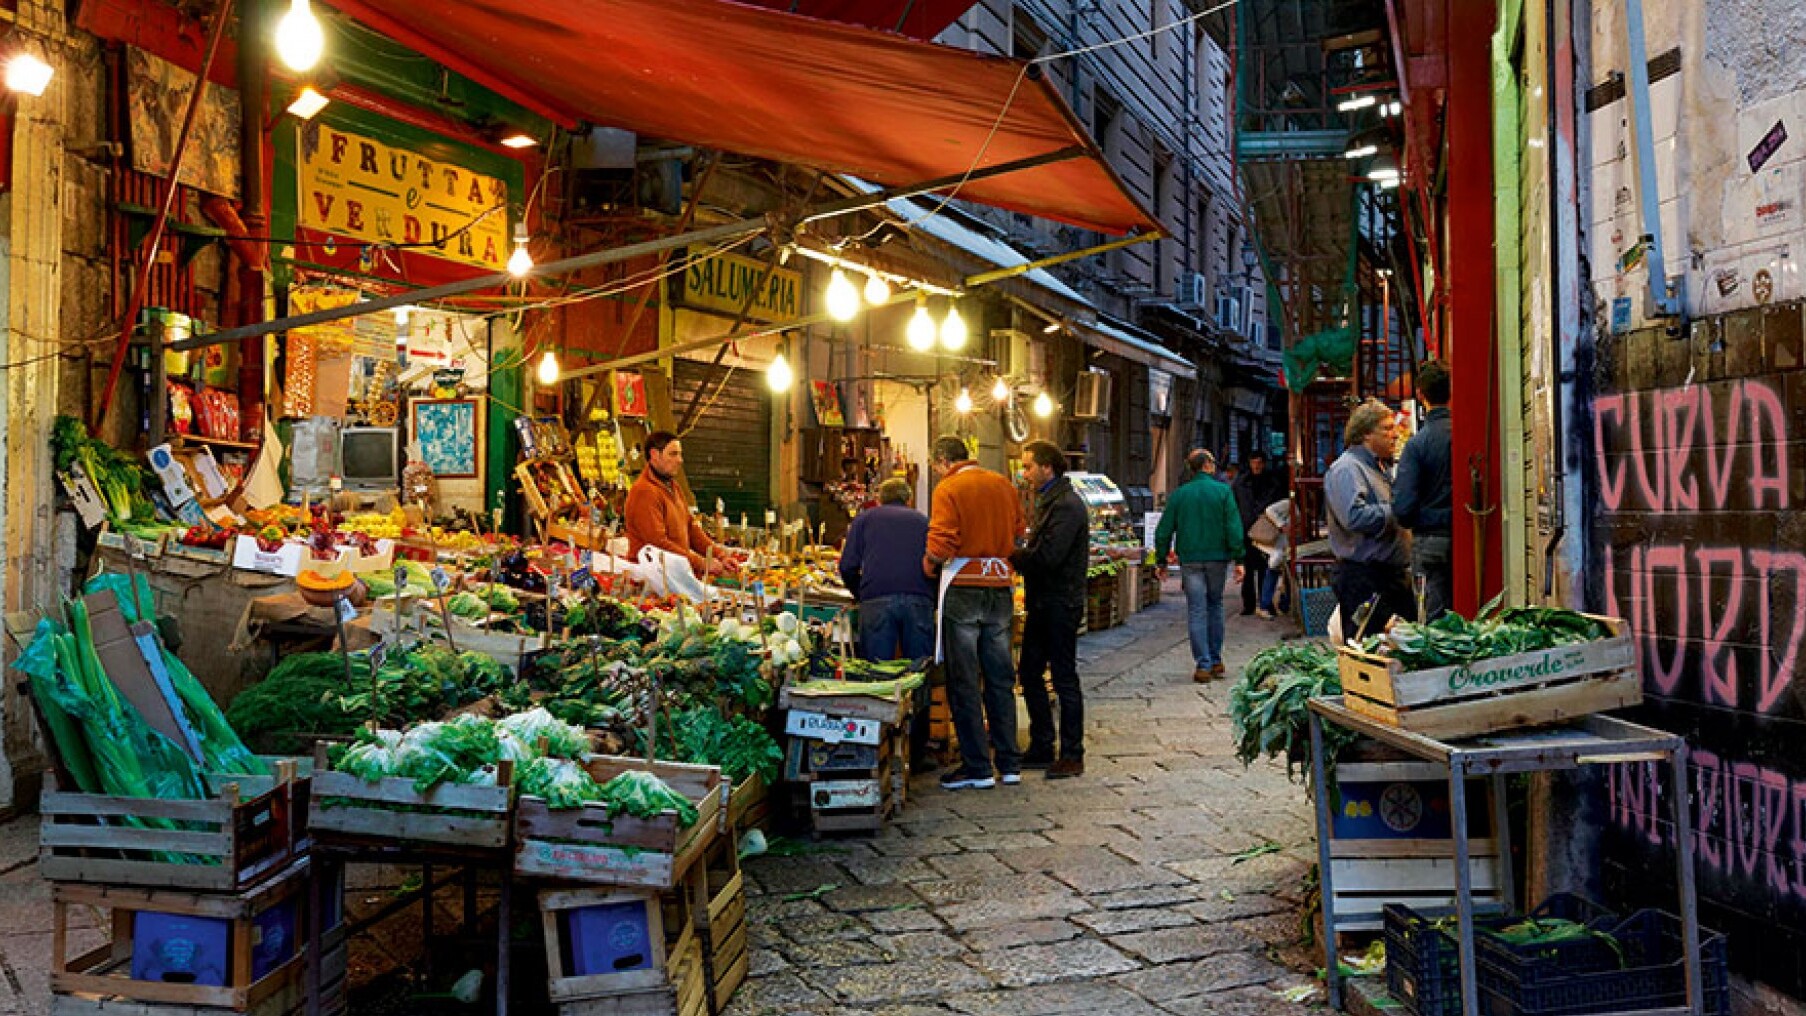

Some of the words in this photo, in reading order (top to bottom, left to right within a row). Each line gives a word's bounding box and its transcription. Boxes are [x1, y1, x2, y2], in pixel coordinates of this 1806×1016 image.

[330, 133, 484, 205] FRUTTA
[313, 191, 499, 263] VERDURA
[1592, 381, 1789, 511] CURVA
[1448, 653, 1564, 690] Oroverde
